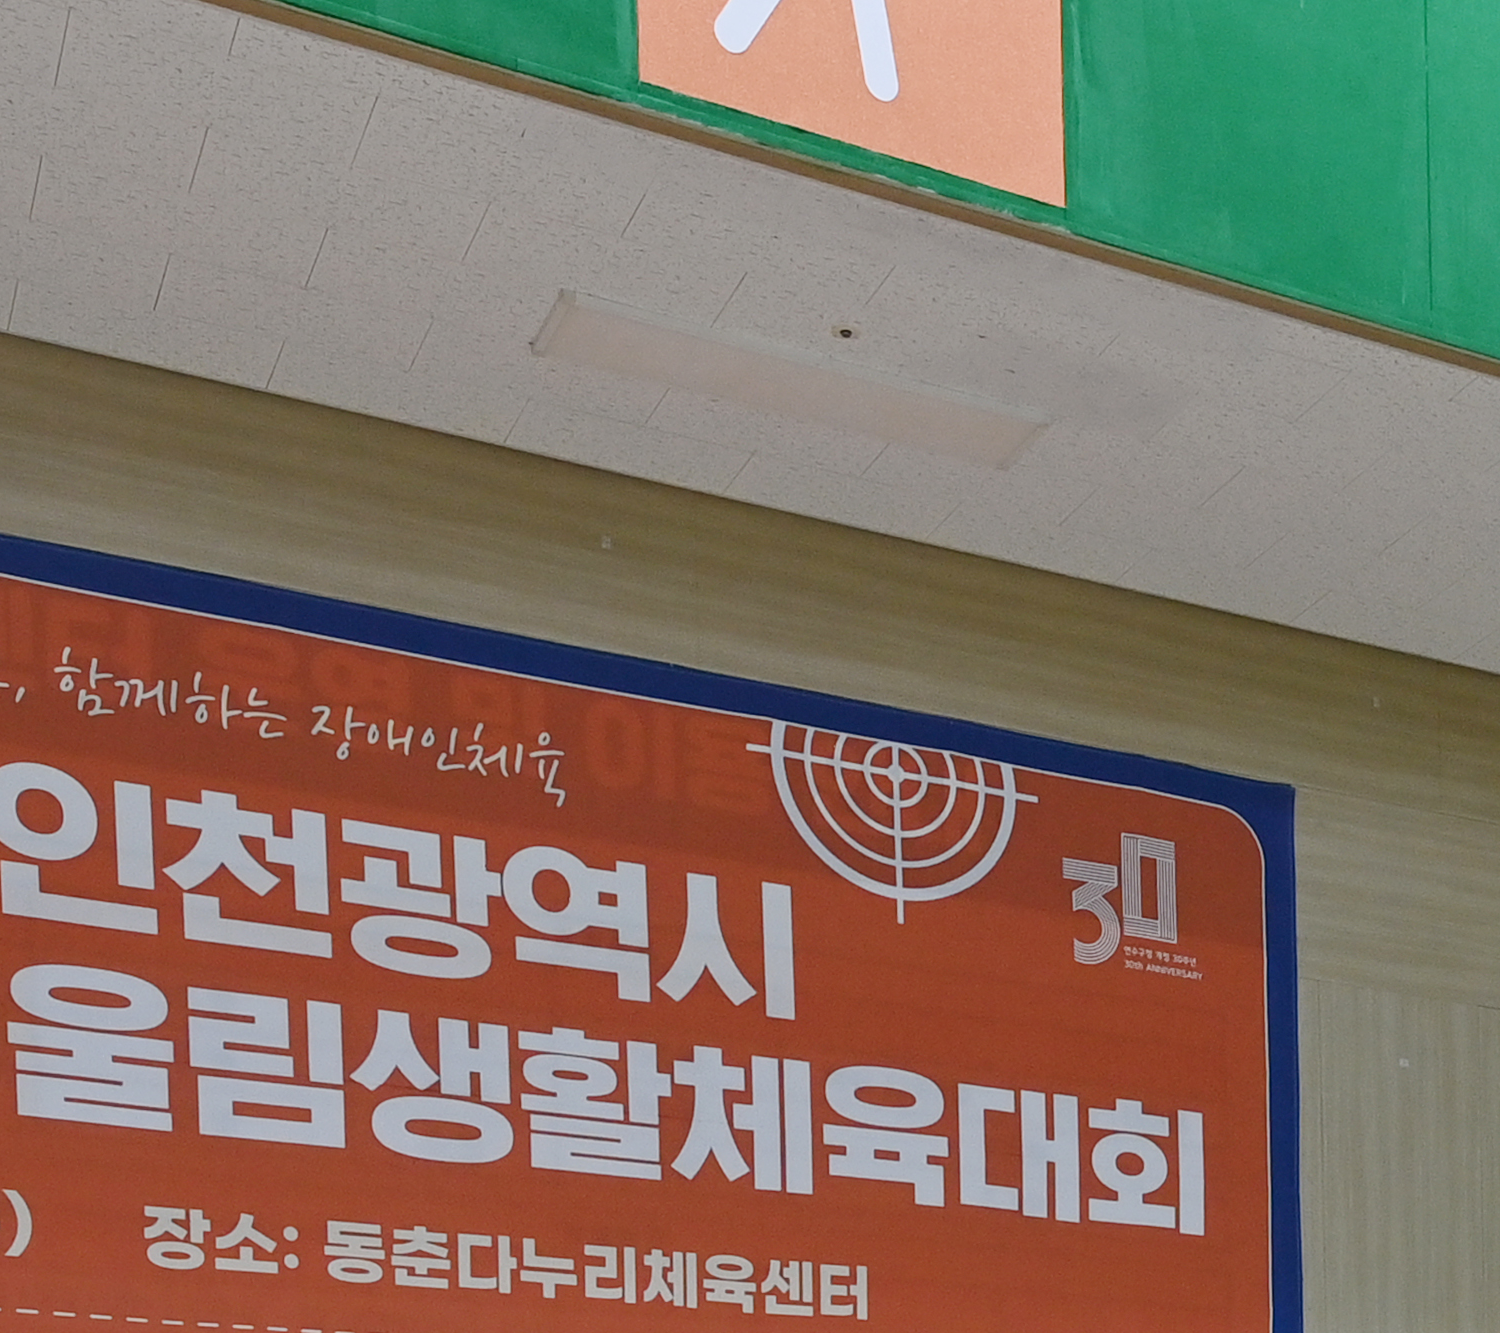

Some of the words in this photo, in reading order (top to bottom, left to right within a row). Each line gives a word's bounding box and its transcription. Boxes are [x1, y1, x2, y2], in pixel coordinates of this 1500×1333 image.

[54, 647, 287, 738] 함께하는
[311, 706, 566, 807] 장애인체육
[144, 1206, 301, 1274] 장소:
[324, 1220, 870, 1320] 동춘다누리체육센터
